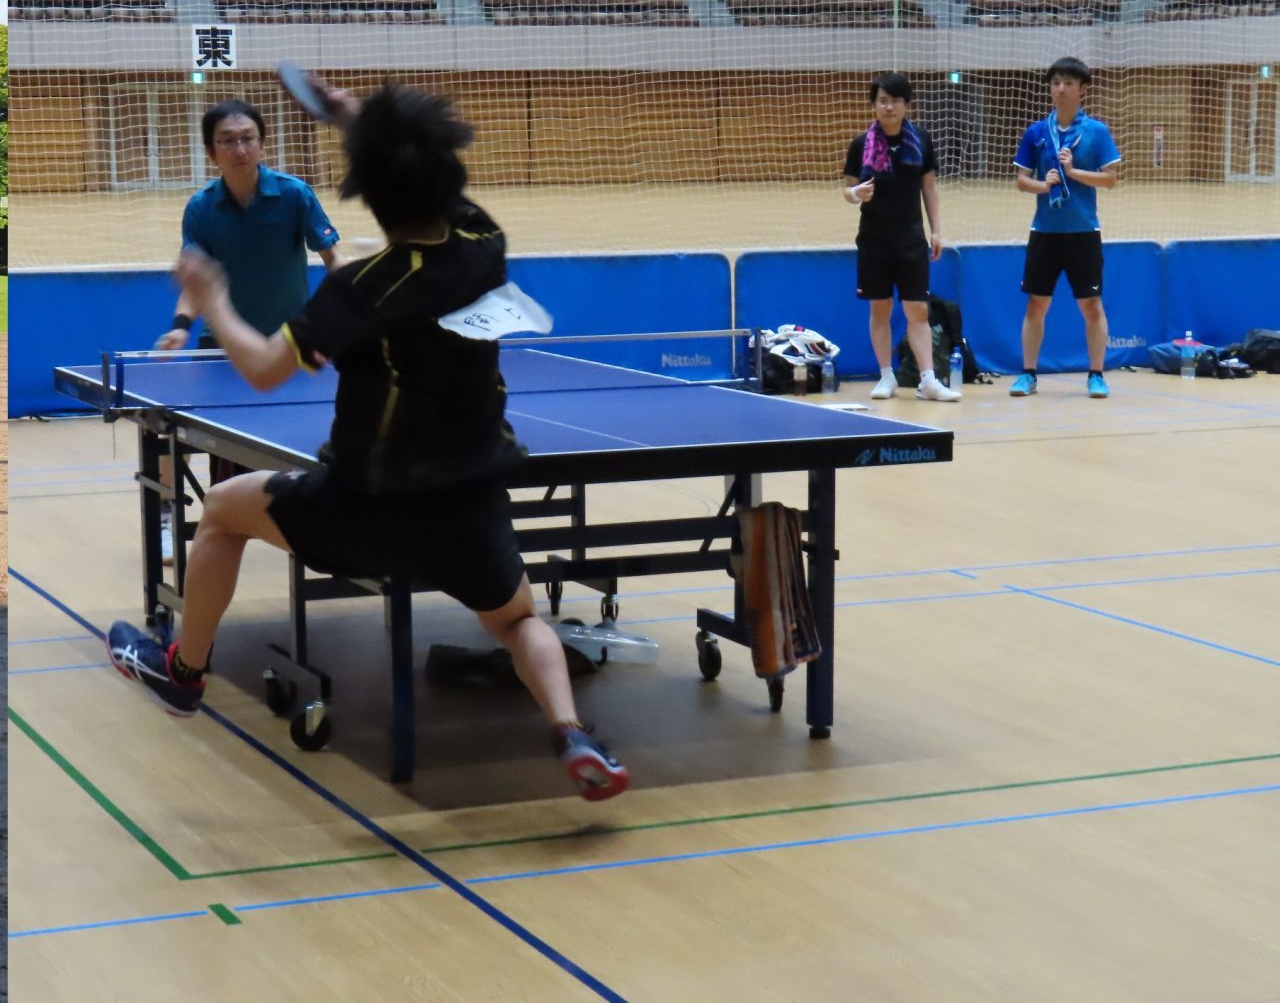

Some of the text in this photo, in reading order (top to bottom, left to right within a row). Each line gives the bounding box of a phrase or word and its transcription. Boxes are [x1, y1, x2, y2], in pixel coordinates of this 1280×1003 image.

[195, 26, 233, 67] 東
[661, 353, 712, 367] Nittaku
[879, 445, 936, 463] Nittaku
